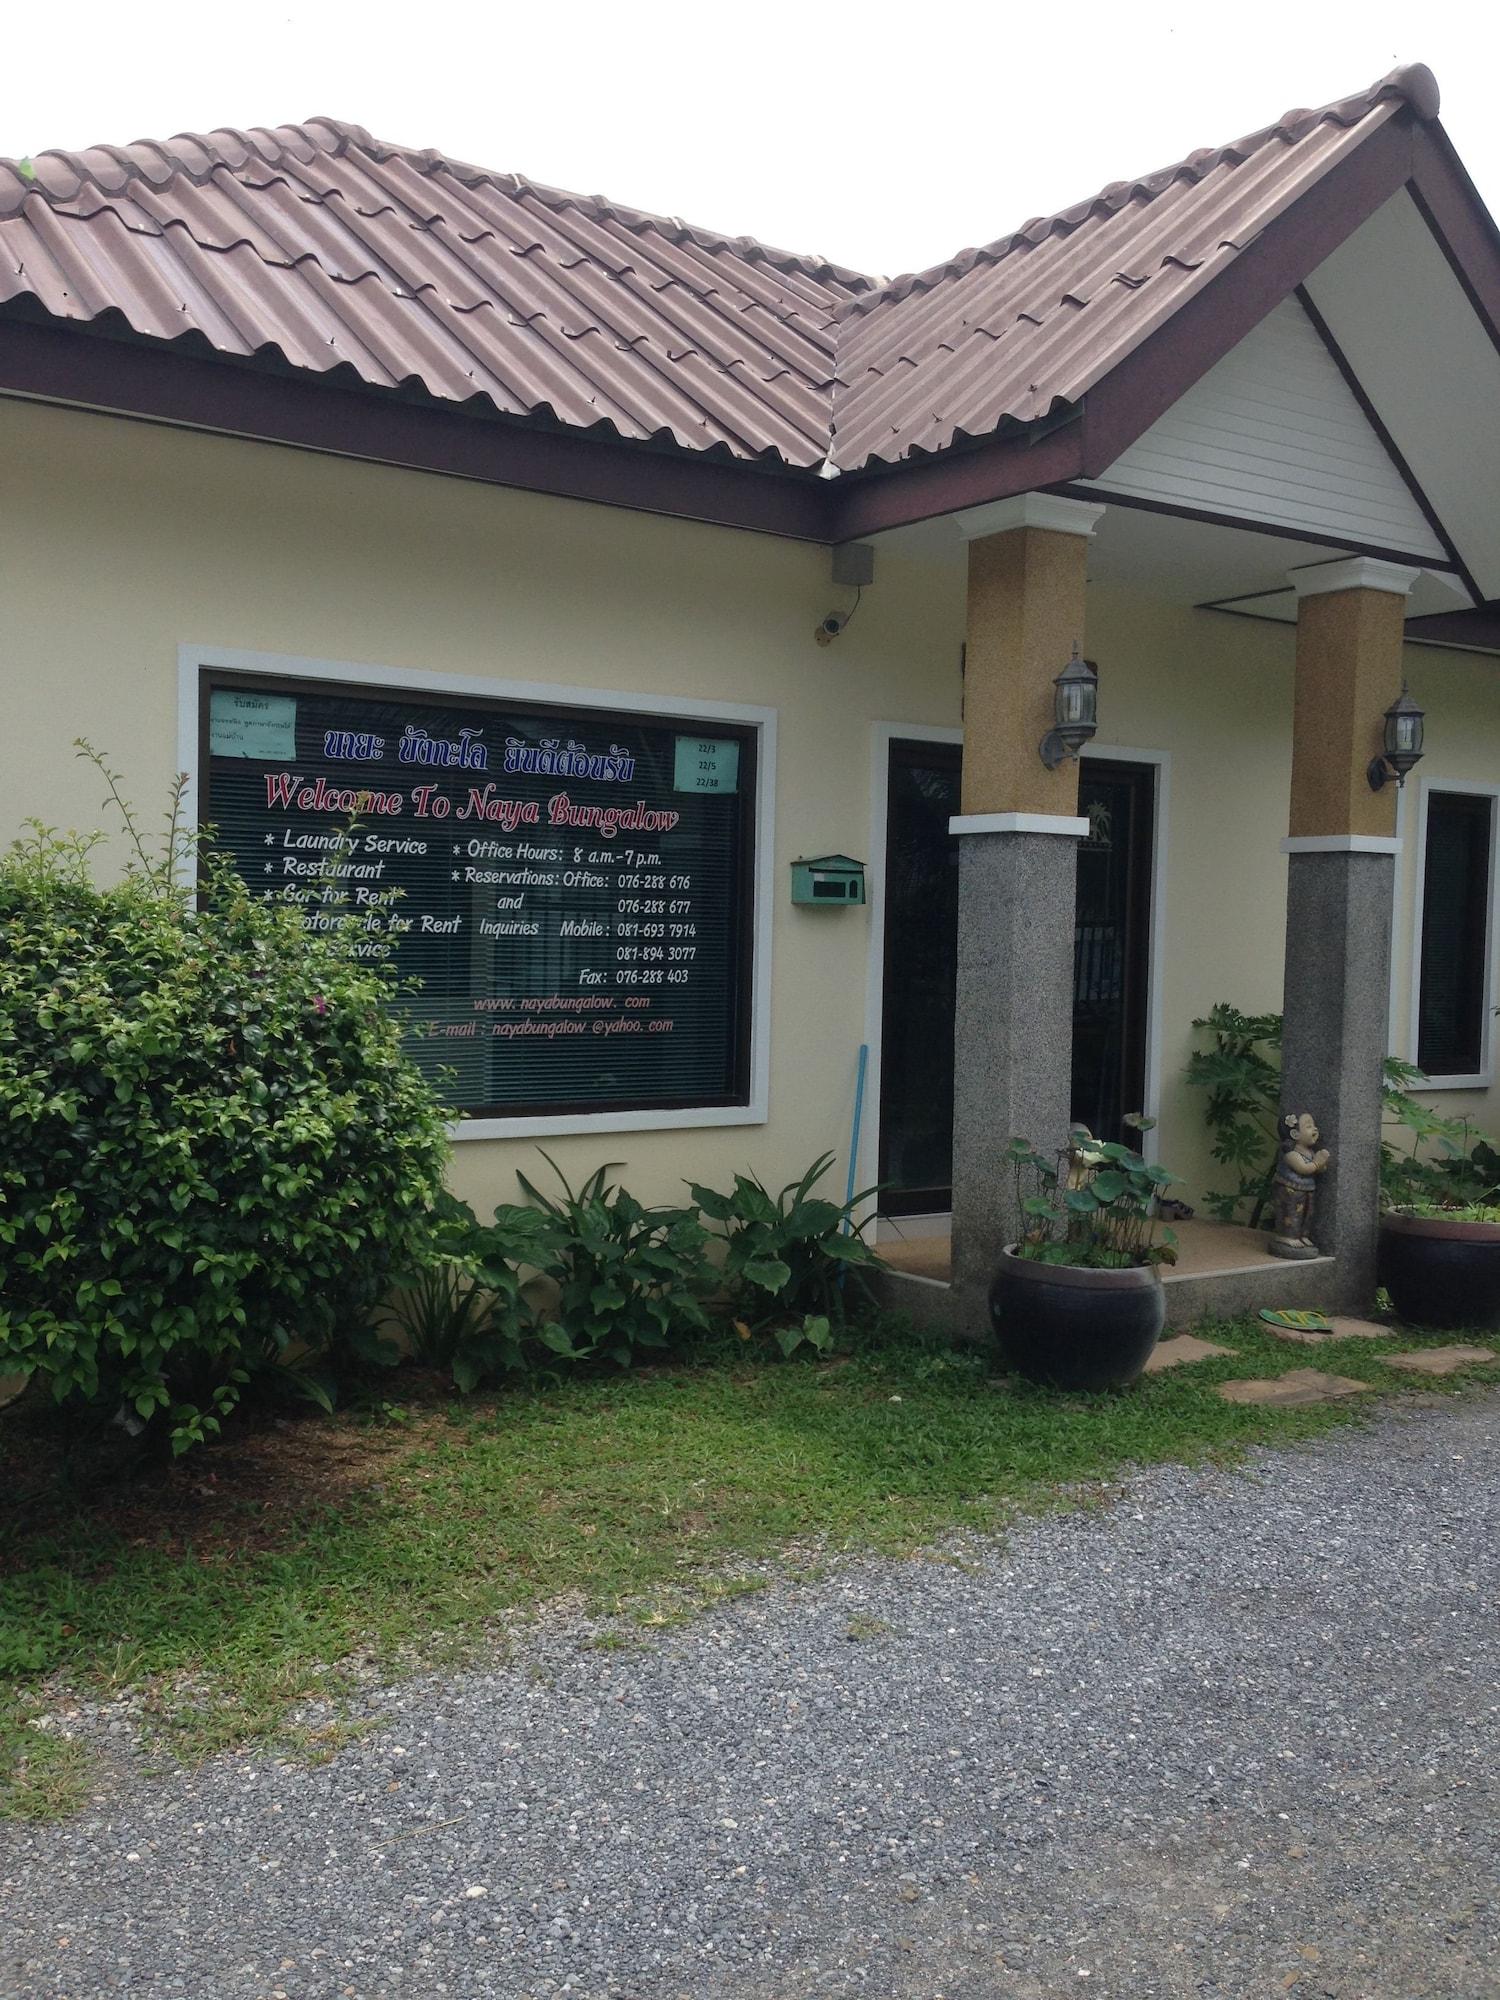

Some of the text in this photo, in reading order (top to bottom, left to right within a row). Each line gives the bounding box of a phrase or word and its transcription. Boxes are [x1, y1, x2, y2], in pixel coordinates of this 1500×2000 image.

[324, 725, 636, 783] นายะ บังกะโล ยินดีต้อนรับ
[698, 744, 716, 754] 22/3
[699, 761, 717, 772] 22/5
[696, 777, 719, 788] 22/38
[263, 772, 680, 839] Welcome To Naya Bungalow
[364, 834, 428, 855] Service
[467, 838, 513, 858] Office
[516, 842, 564, 861] Hours:
[573, 847, 584, 863] 8
[464, 866, 691, 889] Reservations: Office: 076-288 676
[497, 892, 525, 909] and
[617, 898, 692, 914] 076-288 677
[421, 914, 462, 934] Rent
[479, 918, 540, 940] Inquiries
[617, 922, 665, 938] 081-693
[669, 922, 697, 938] 7914
[616, 946, 697, 961] 081-894 3077
[578, 968, 689, 985] Fax: 076-288 403
[624, 996, 651, 1008] com
[492, 1017, 588, 1040] nayabungalow
